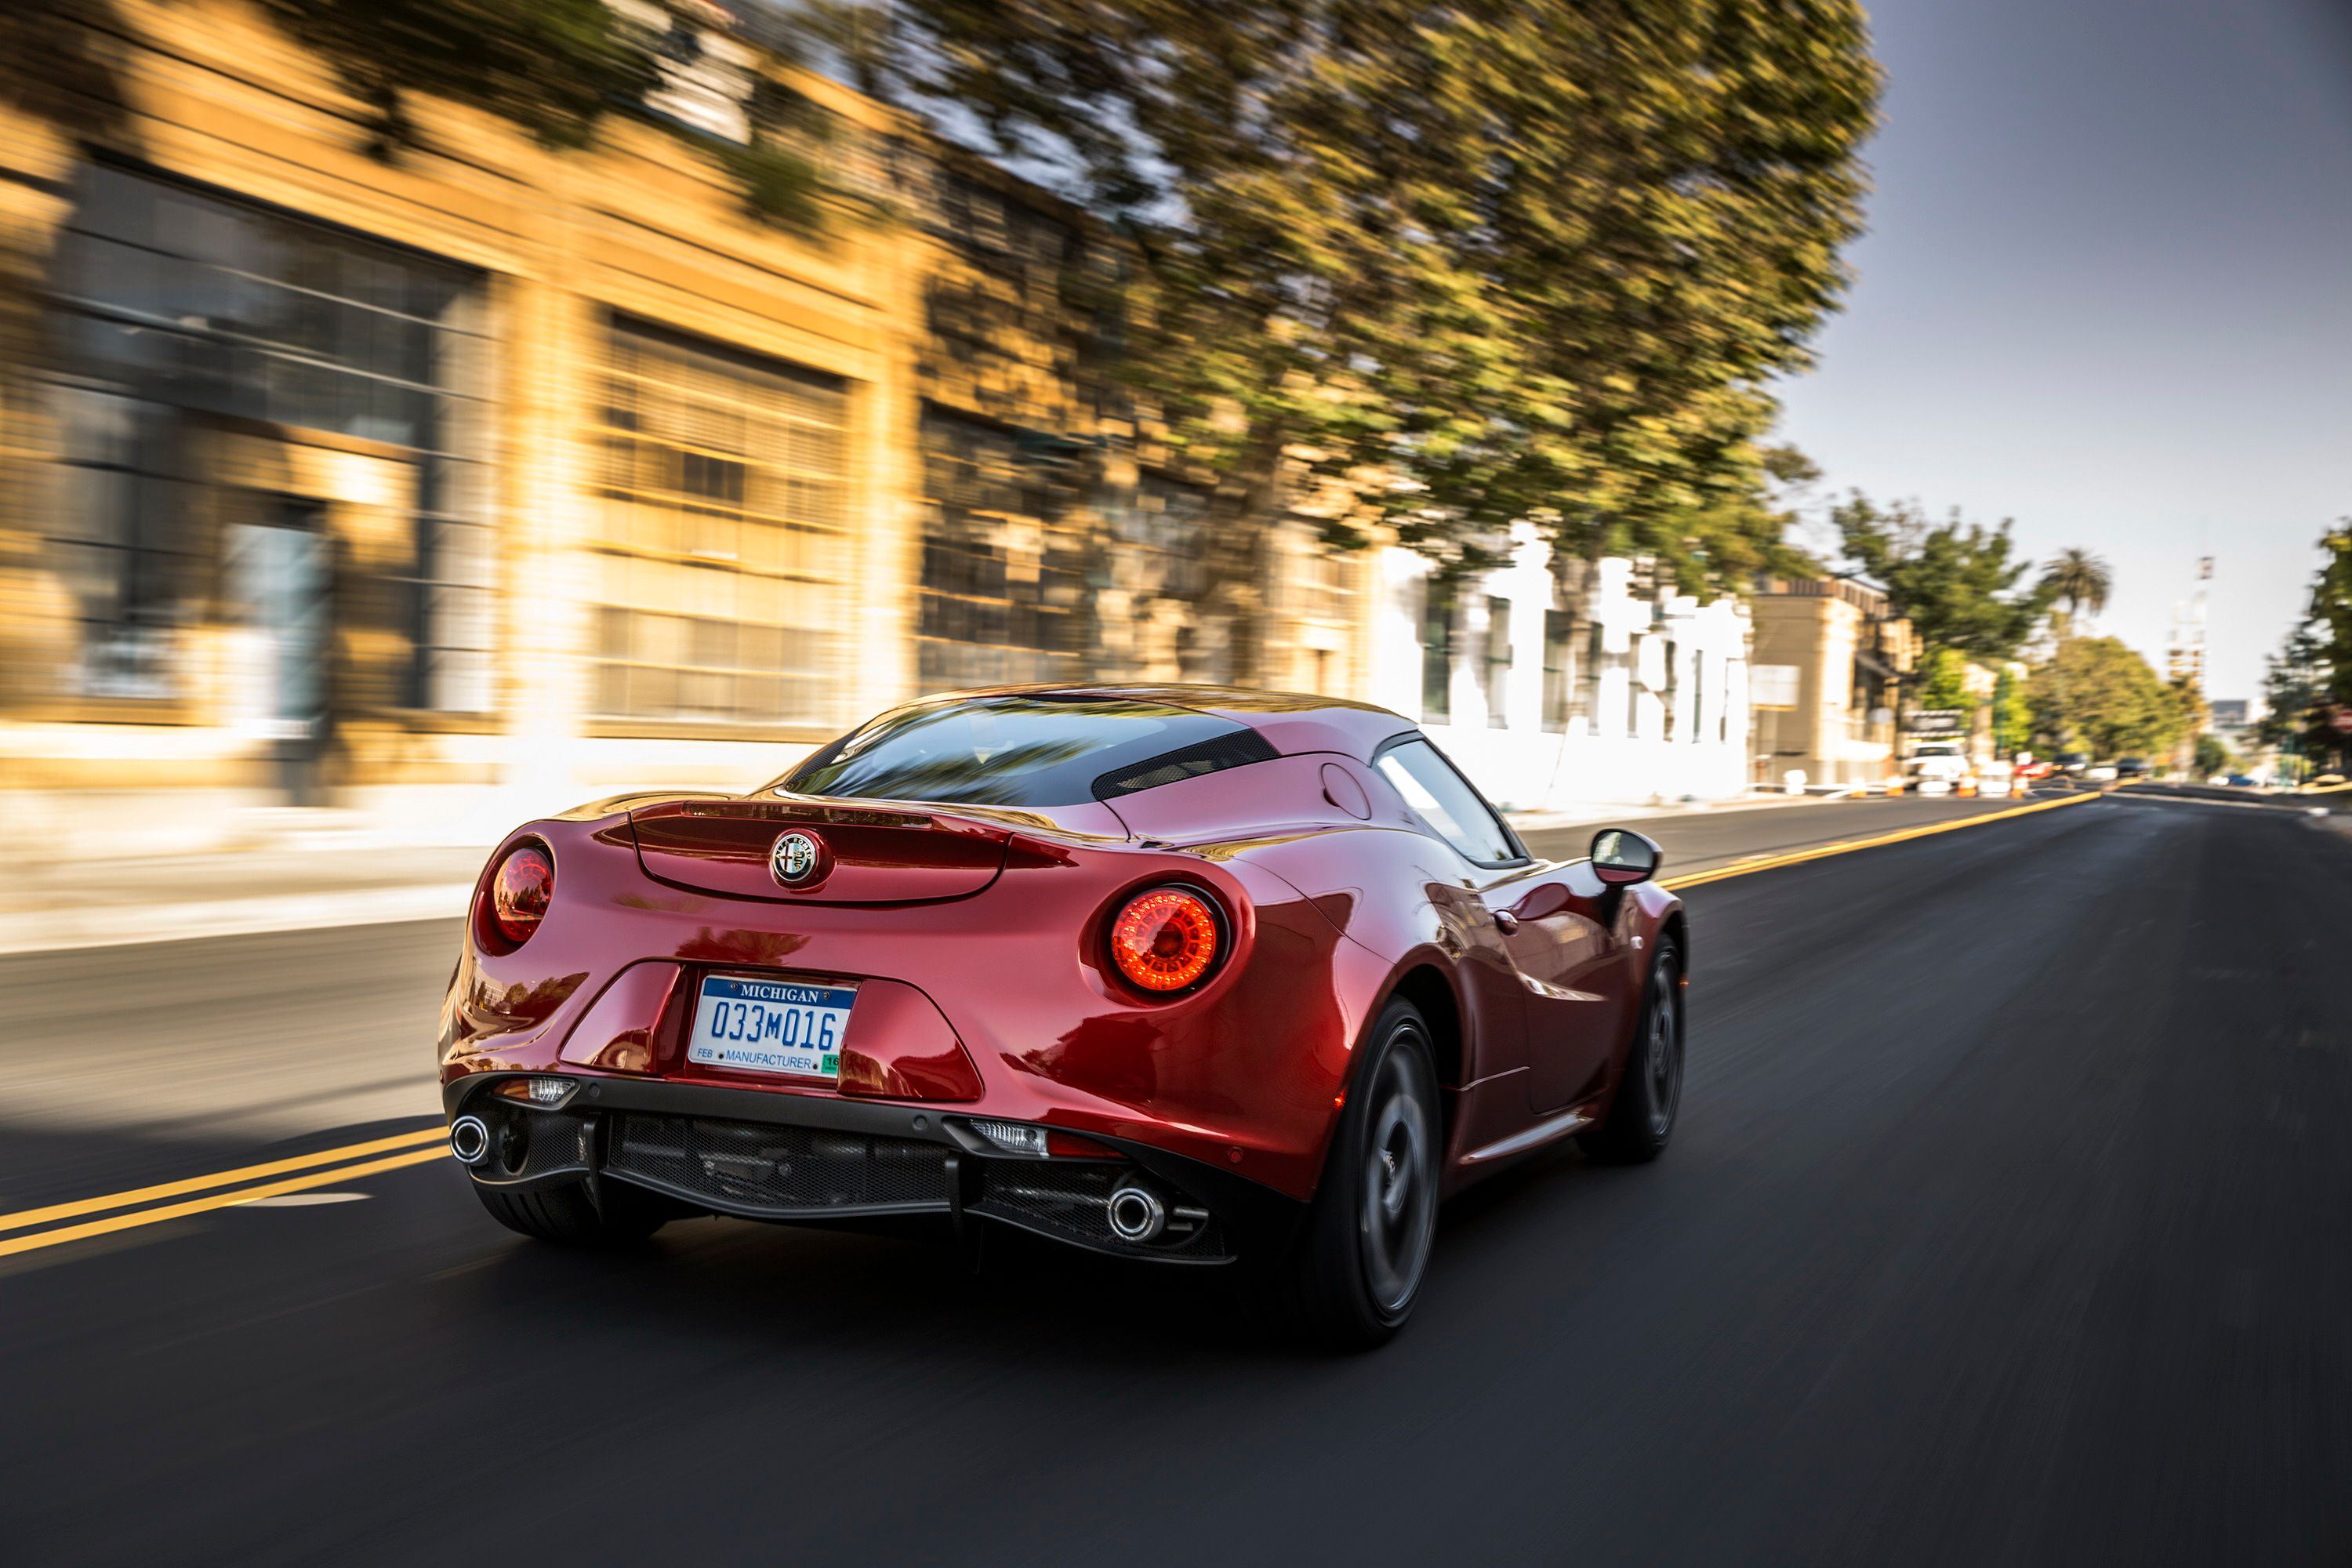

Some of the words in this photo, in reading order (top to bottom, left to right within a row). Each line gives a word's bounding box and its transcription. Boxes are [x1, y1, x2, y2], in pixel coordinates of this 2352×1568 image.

[793, 837, 812, 860] ROMEO
[740, 984, 819, 1004] MICHIGAN
[711, 1001, 837, 1051] 033M016
[697, 1047, 713, 1058] FEB
[726, 1050, 811, 1069] MANUFACTURER
[827, 1057, 839, 1066] 16
